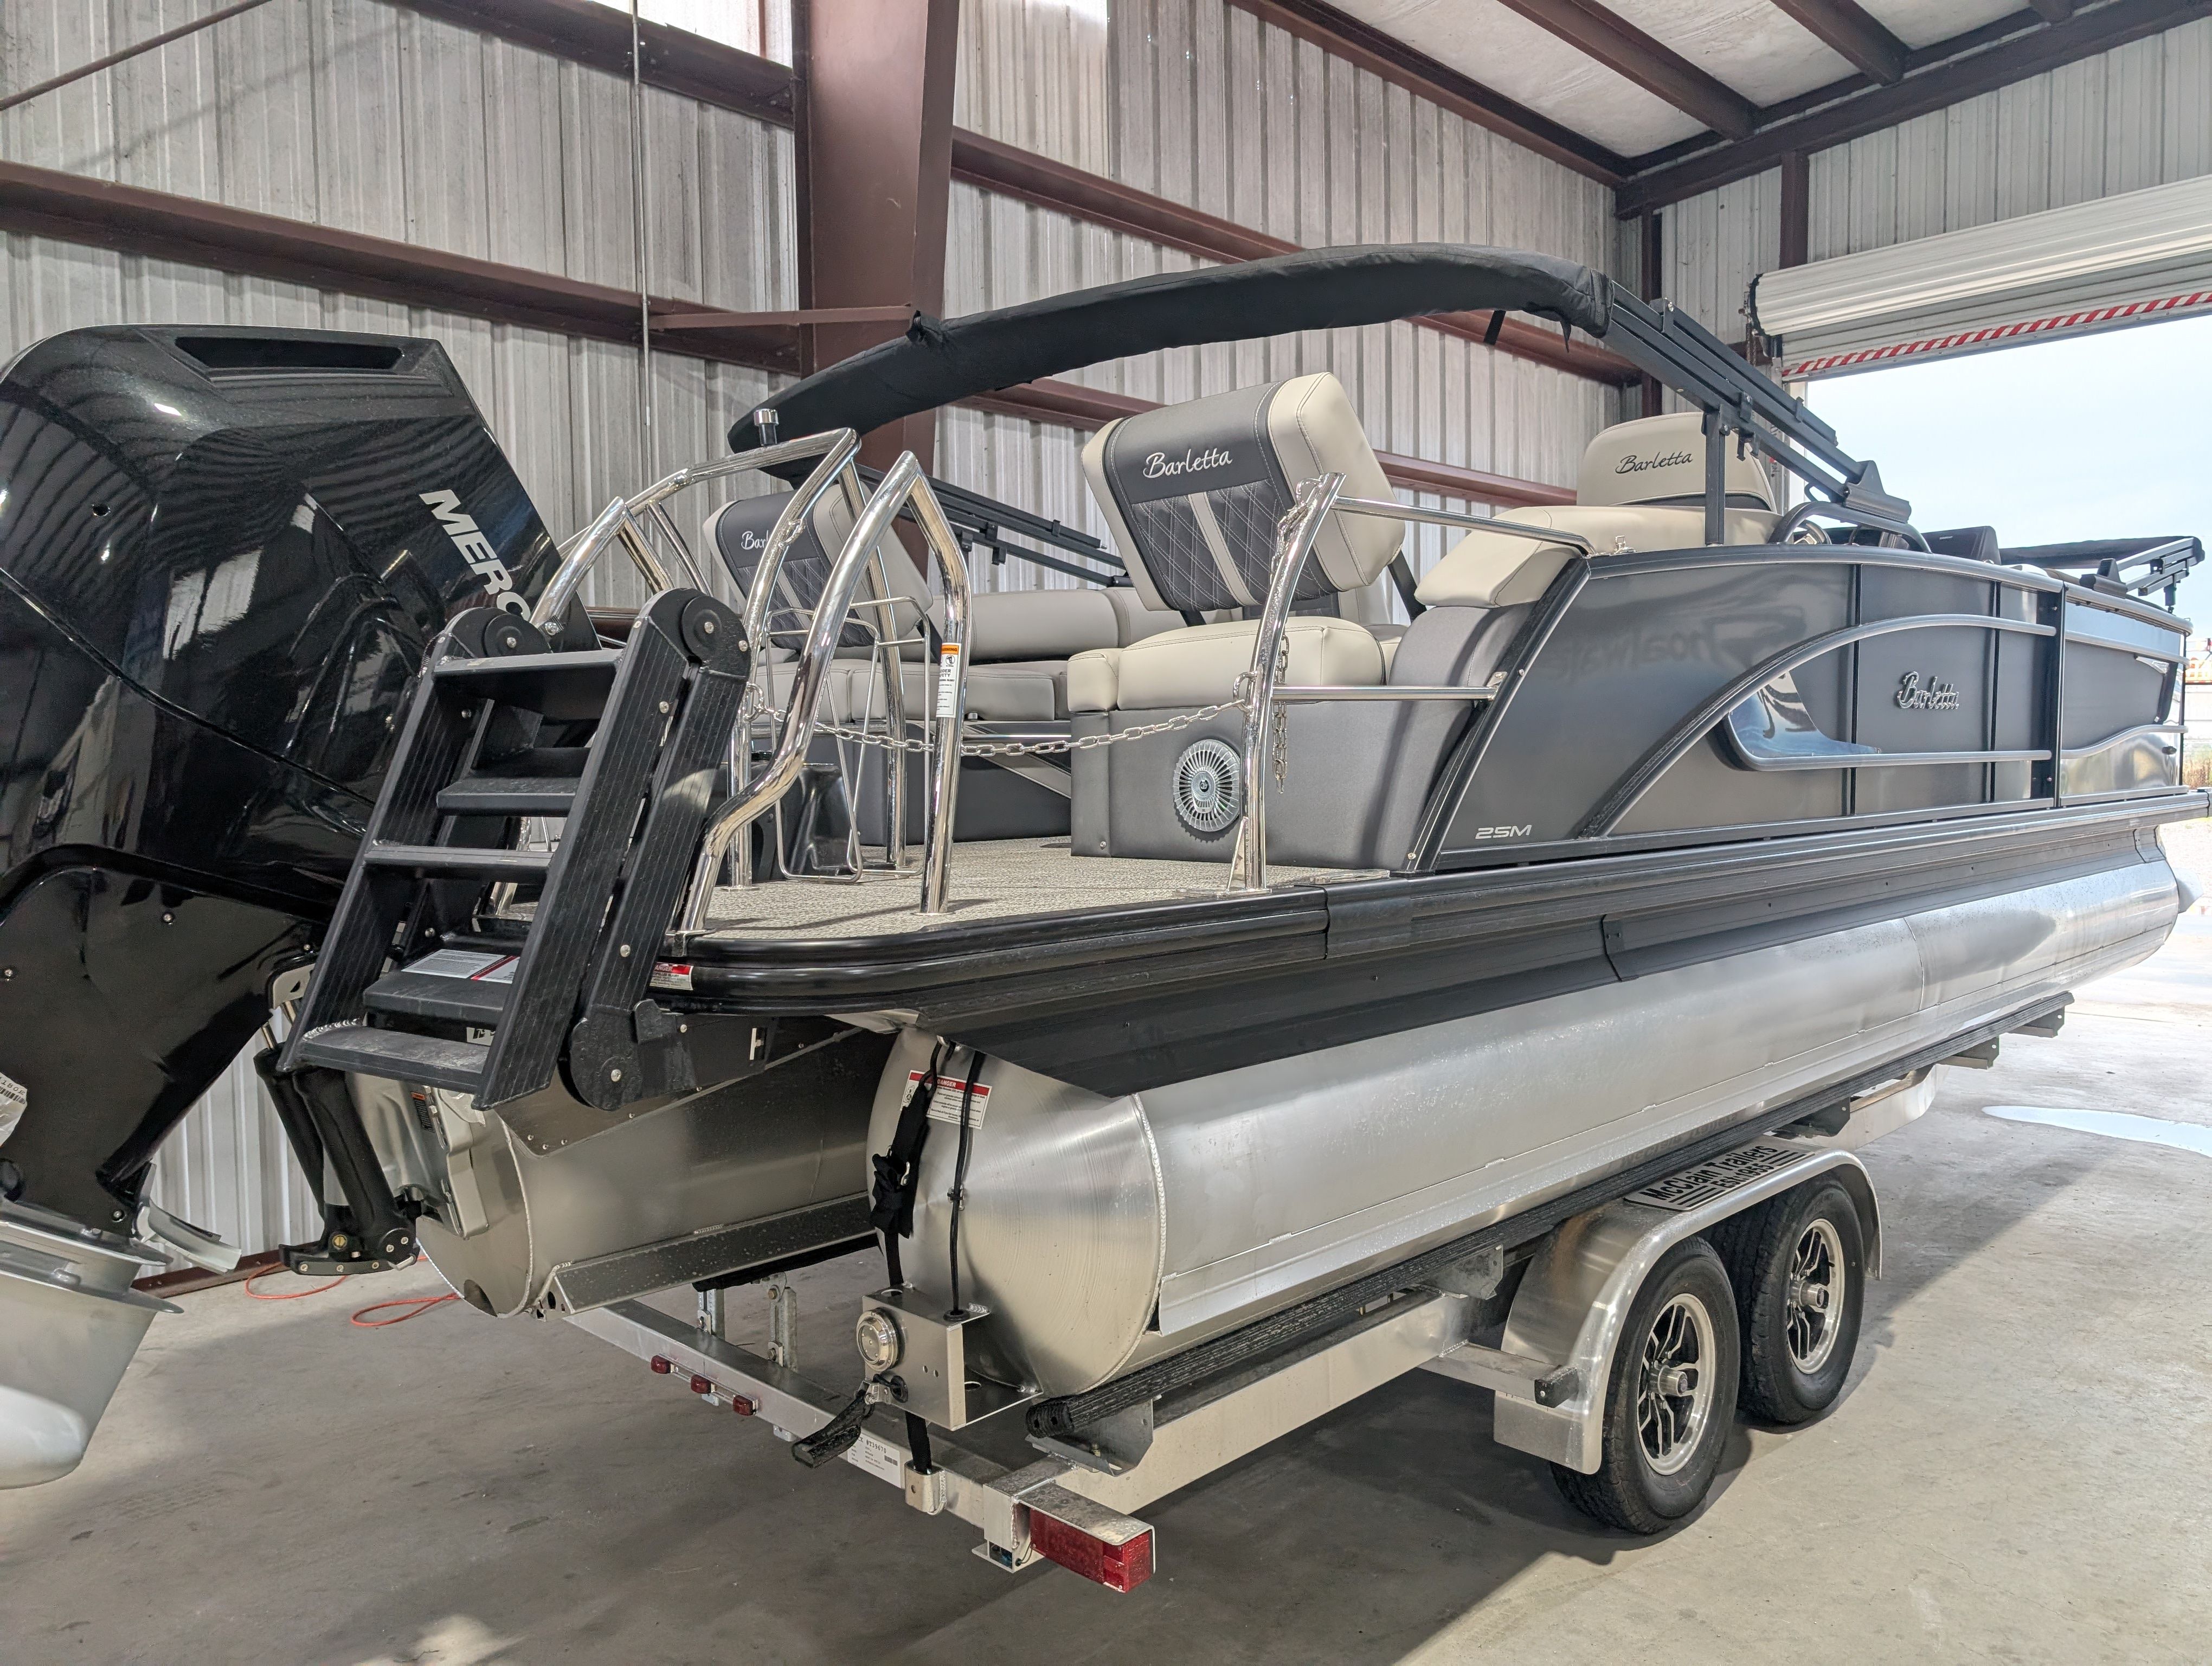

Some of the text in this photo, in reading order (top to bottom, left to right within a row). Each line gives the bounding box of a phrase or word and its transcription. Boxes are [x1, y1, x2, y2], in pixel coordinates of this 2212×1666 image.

[1142, 447, 1233, 478] Barletta
[1615, 451, 1693, 474] Barletta
[741, 530, 769, 550] Barl
[419, 489, 531, 622] MERC
[1897, 671, 1959, 710] Barletta
[1475, 824, 1532, 840] 25M
[937, 1079, 956, 1088] DANGER
[1638, 1169, 1722, 1200] McClain
[1703, 1145, 1778, 1170] Trailers
